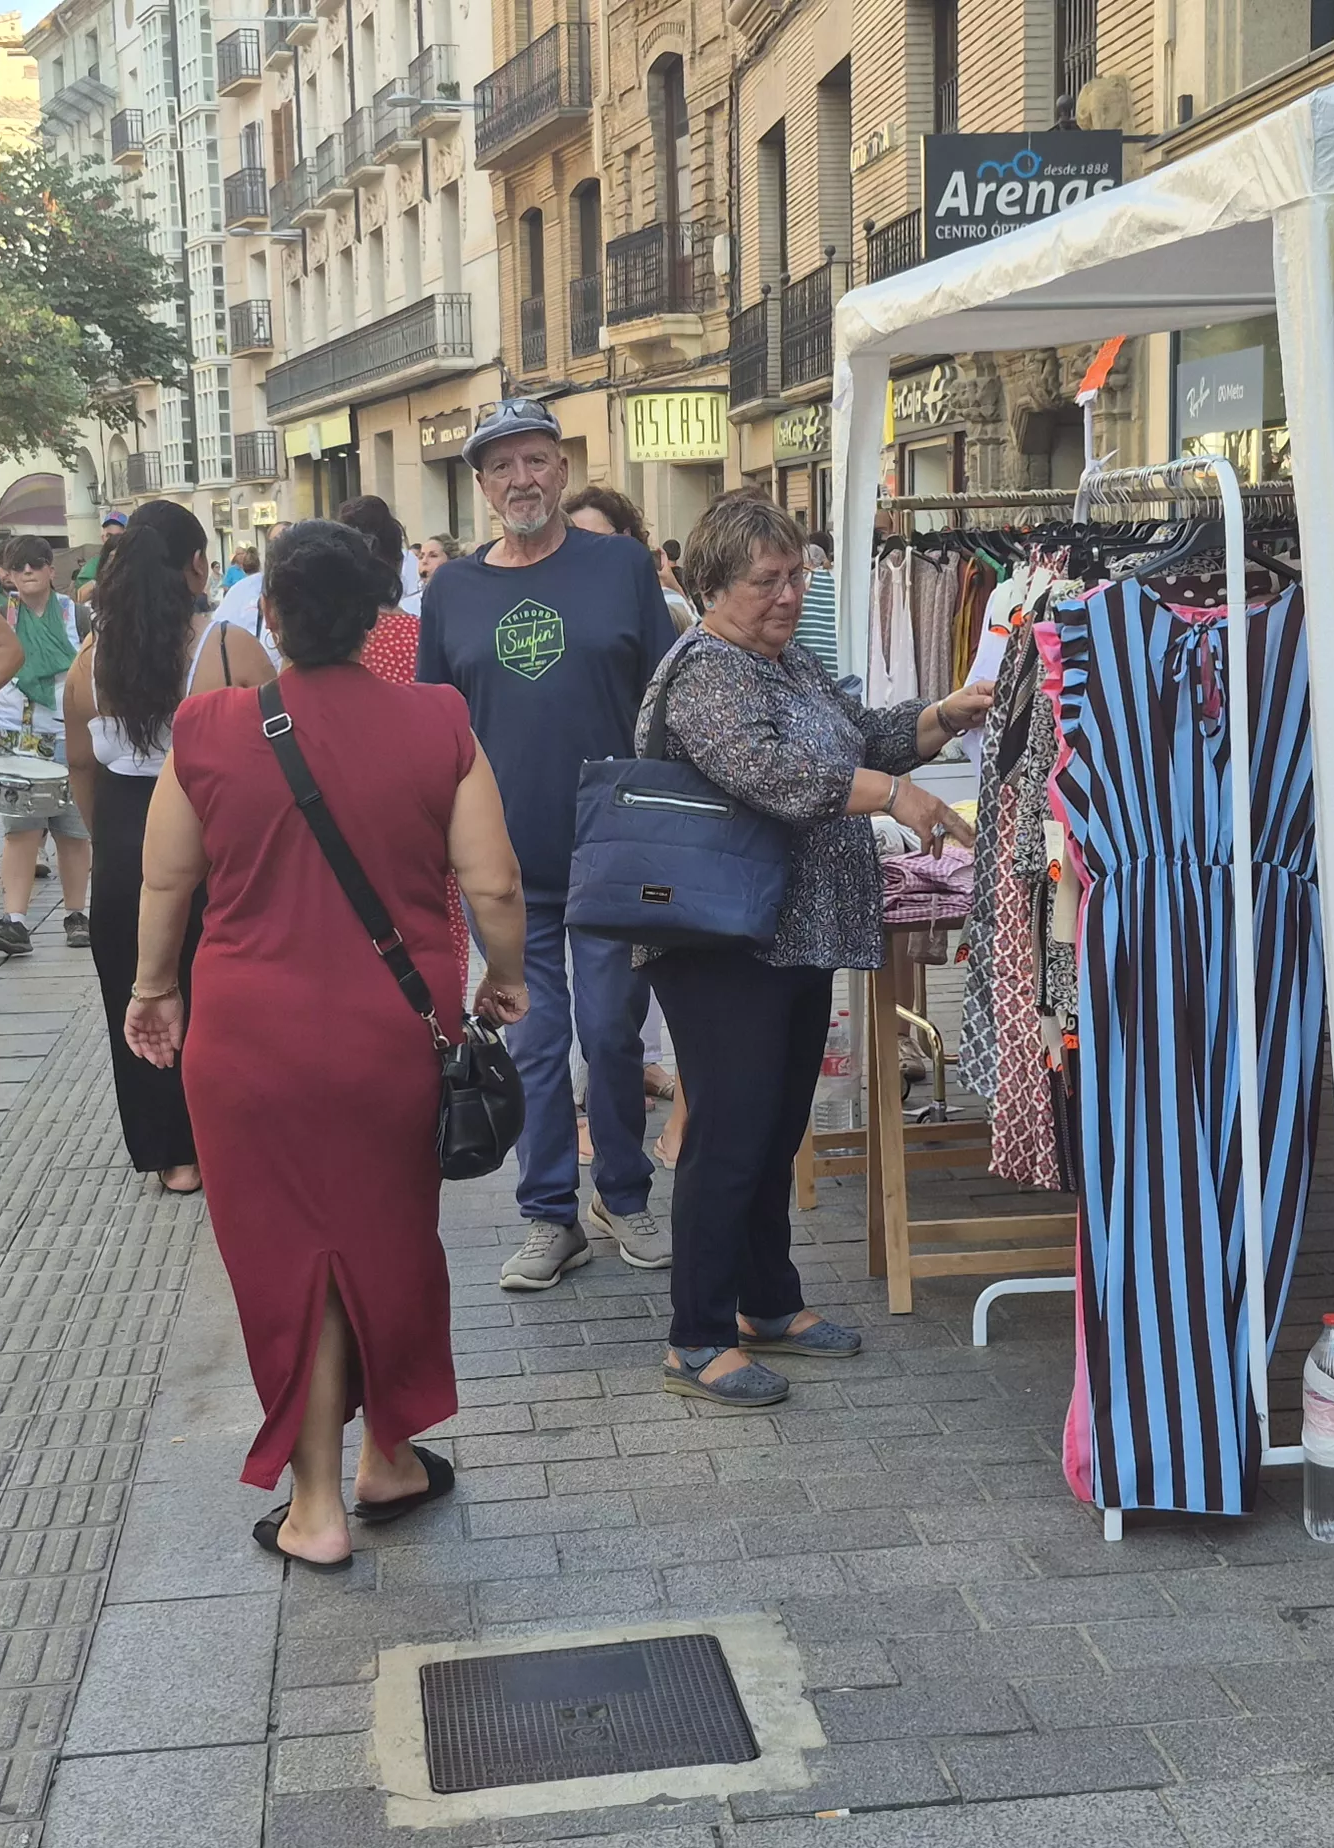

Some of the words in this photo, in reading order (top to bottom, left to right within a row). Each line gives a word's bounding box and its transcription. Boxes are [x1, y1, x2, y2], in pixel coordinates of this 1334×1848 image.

[1043, 163, 1077, 176] desde
[1080, 162, 1109, 175] 1888
[935, 224, 987, 240] CENTRO
[1227, 383, 1244, 401] Meta
[634, 396, 721, 447] ASCASO
[506, 609, 551, 624] TRIBORD
